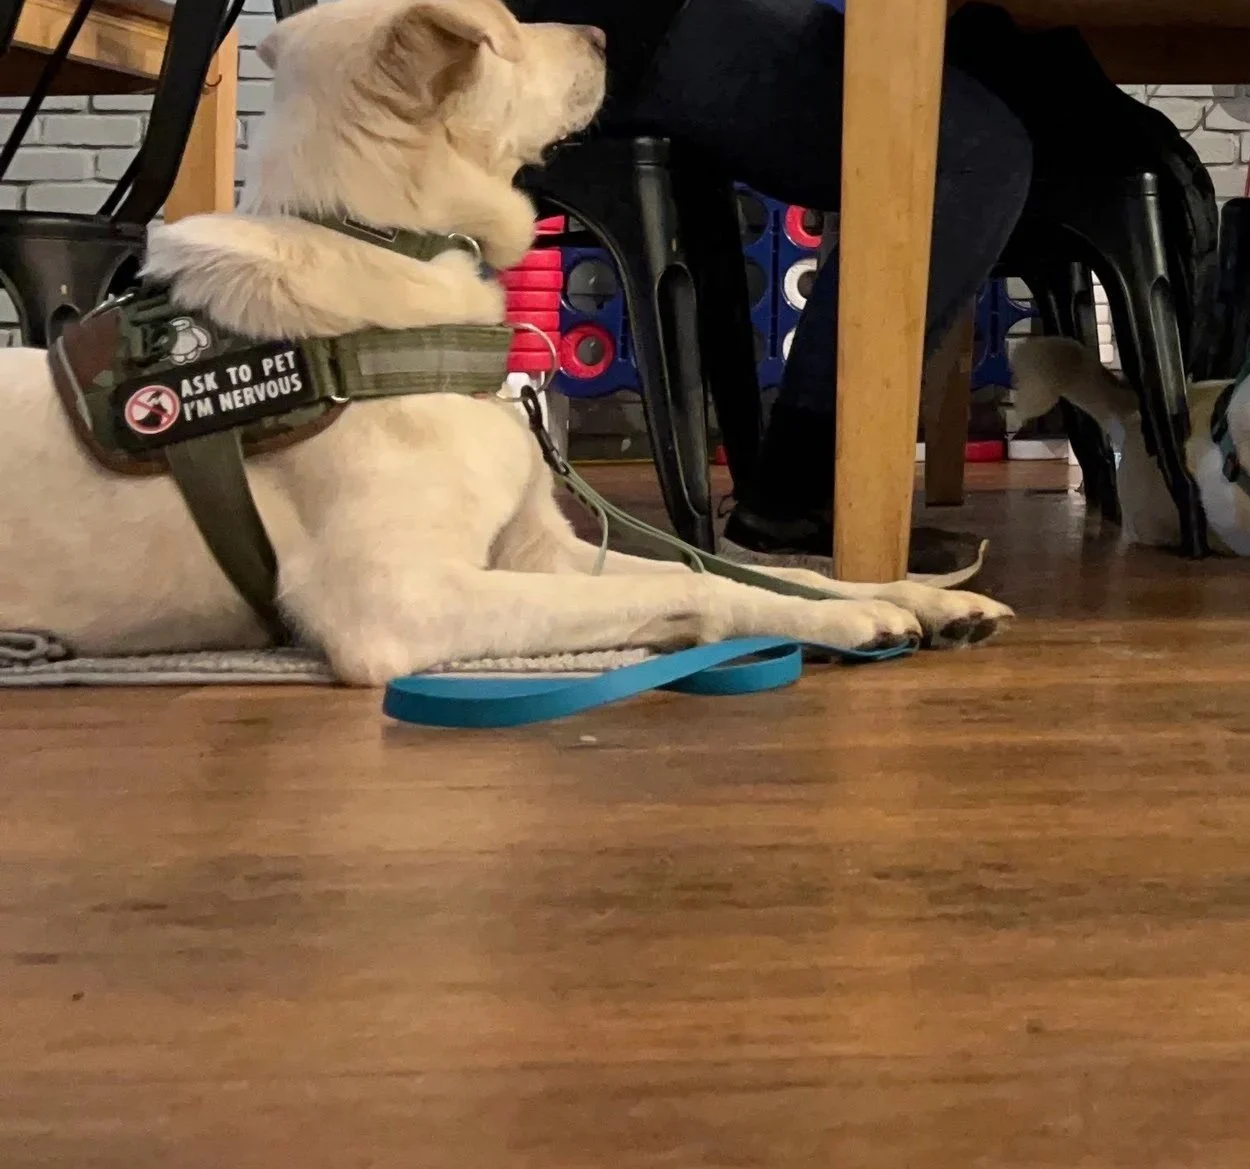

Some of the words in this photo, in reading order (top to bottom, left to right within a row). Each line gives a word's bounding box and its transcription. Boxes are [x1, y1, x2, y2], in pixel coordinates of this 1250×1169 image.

[181, 371, 219, 398] ASK
[226, 364, 252, 385] TO
[261, 350, 295, 376] PET
[183, 397, 214, 421] I'M
[218, 372, 303, 412] NERVOUS
